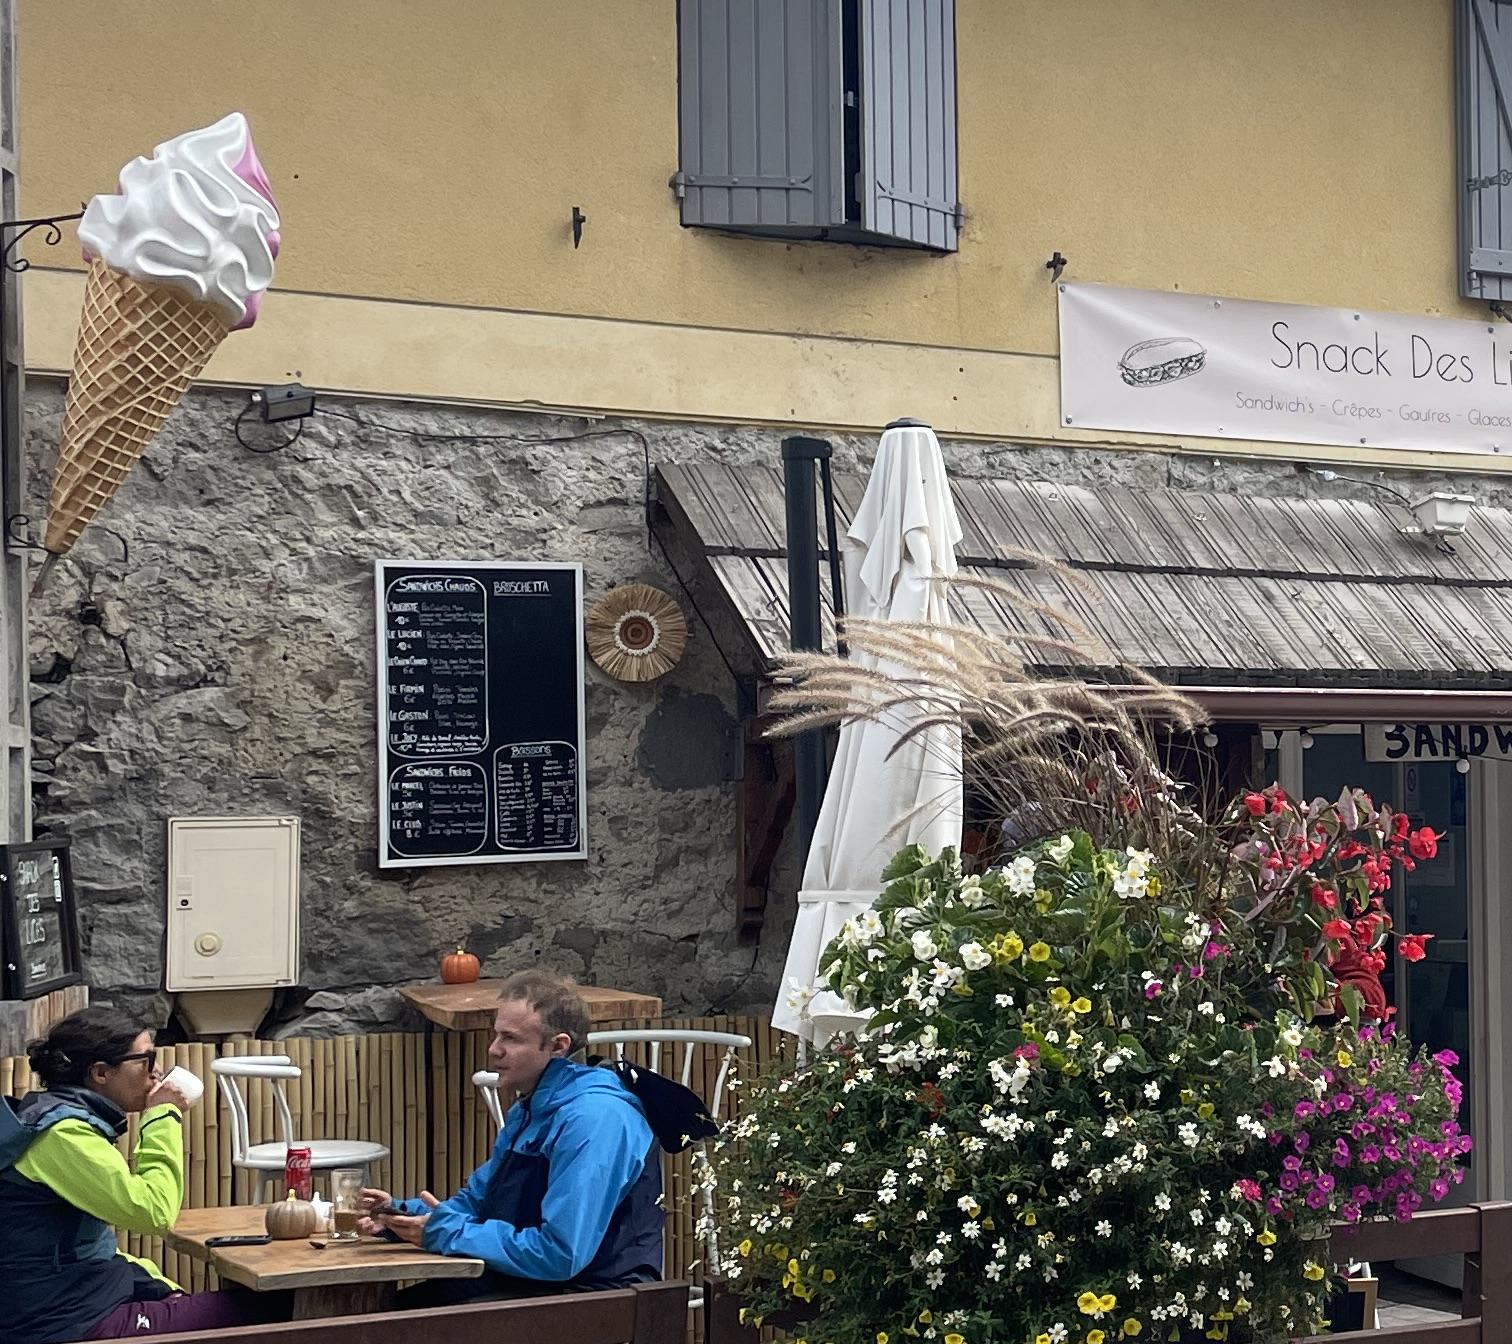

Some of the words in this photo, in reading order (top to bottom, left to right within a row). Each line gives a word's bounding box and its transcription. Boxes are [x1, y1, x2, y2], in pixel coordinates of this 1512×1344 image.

[1270, 321, 1392, 377] Snack
[1411, 334, 1474, 383] Des
[1235, 391, 1314, 415] Sandwich's
[1331, 399, 1382, 420] Crêpes
[1467, 408, 1512, 427] Glaces
